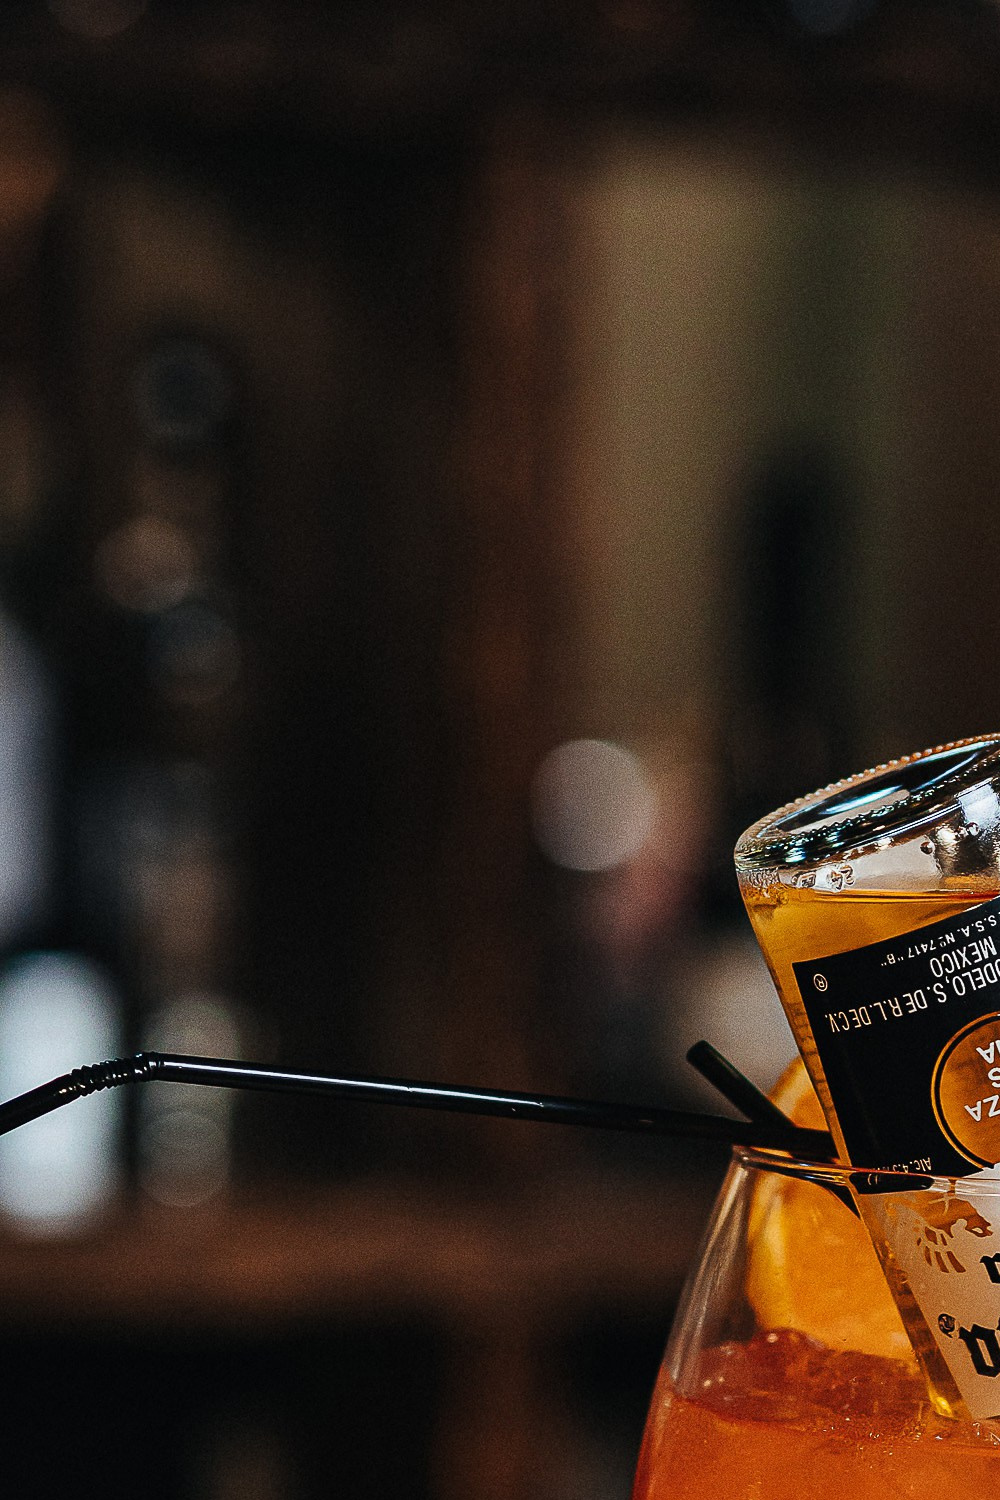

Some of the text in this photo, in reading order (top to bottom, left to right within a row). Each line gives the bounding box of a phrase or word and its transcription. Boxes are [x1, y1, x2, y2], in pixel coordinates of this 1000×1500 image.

[908, 939, 936, 958] 7417
[929, 936, 997, 978] MEXICO
[902, 989, 928, 1013] DE
[926, 982, 947, 1002] S.
[849, 1007, 870, 1029] DE
[869, 998, 902, 1021] R.L.
[824, 1010, 850, 1033] C.V.
